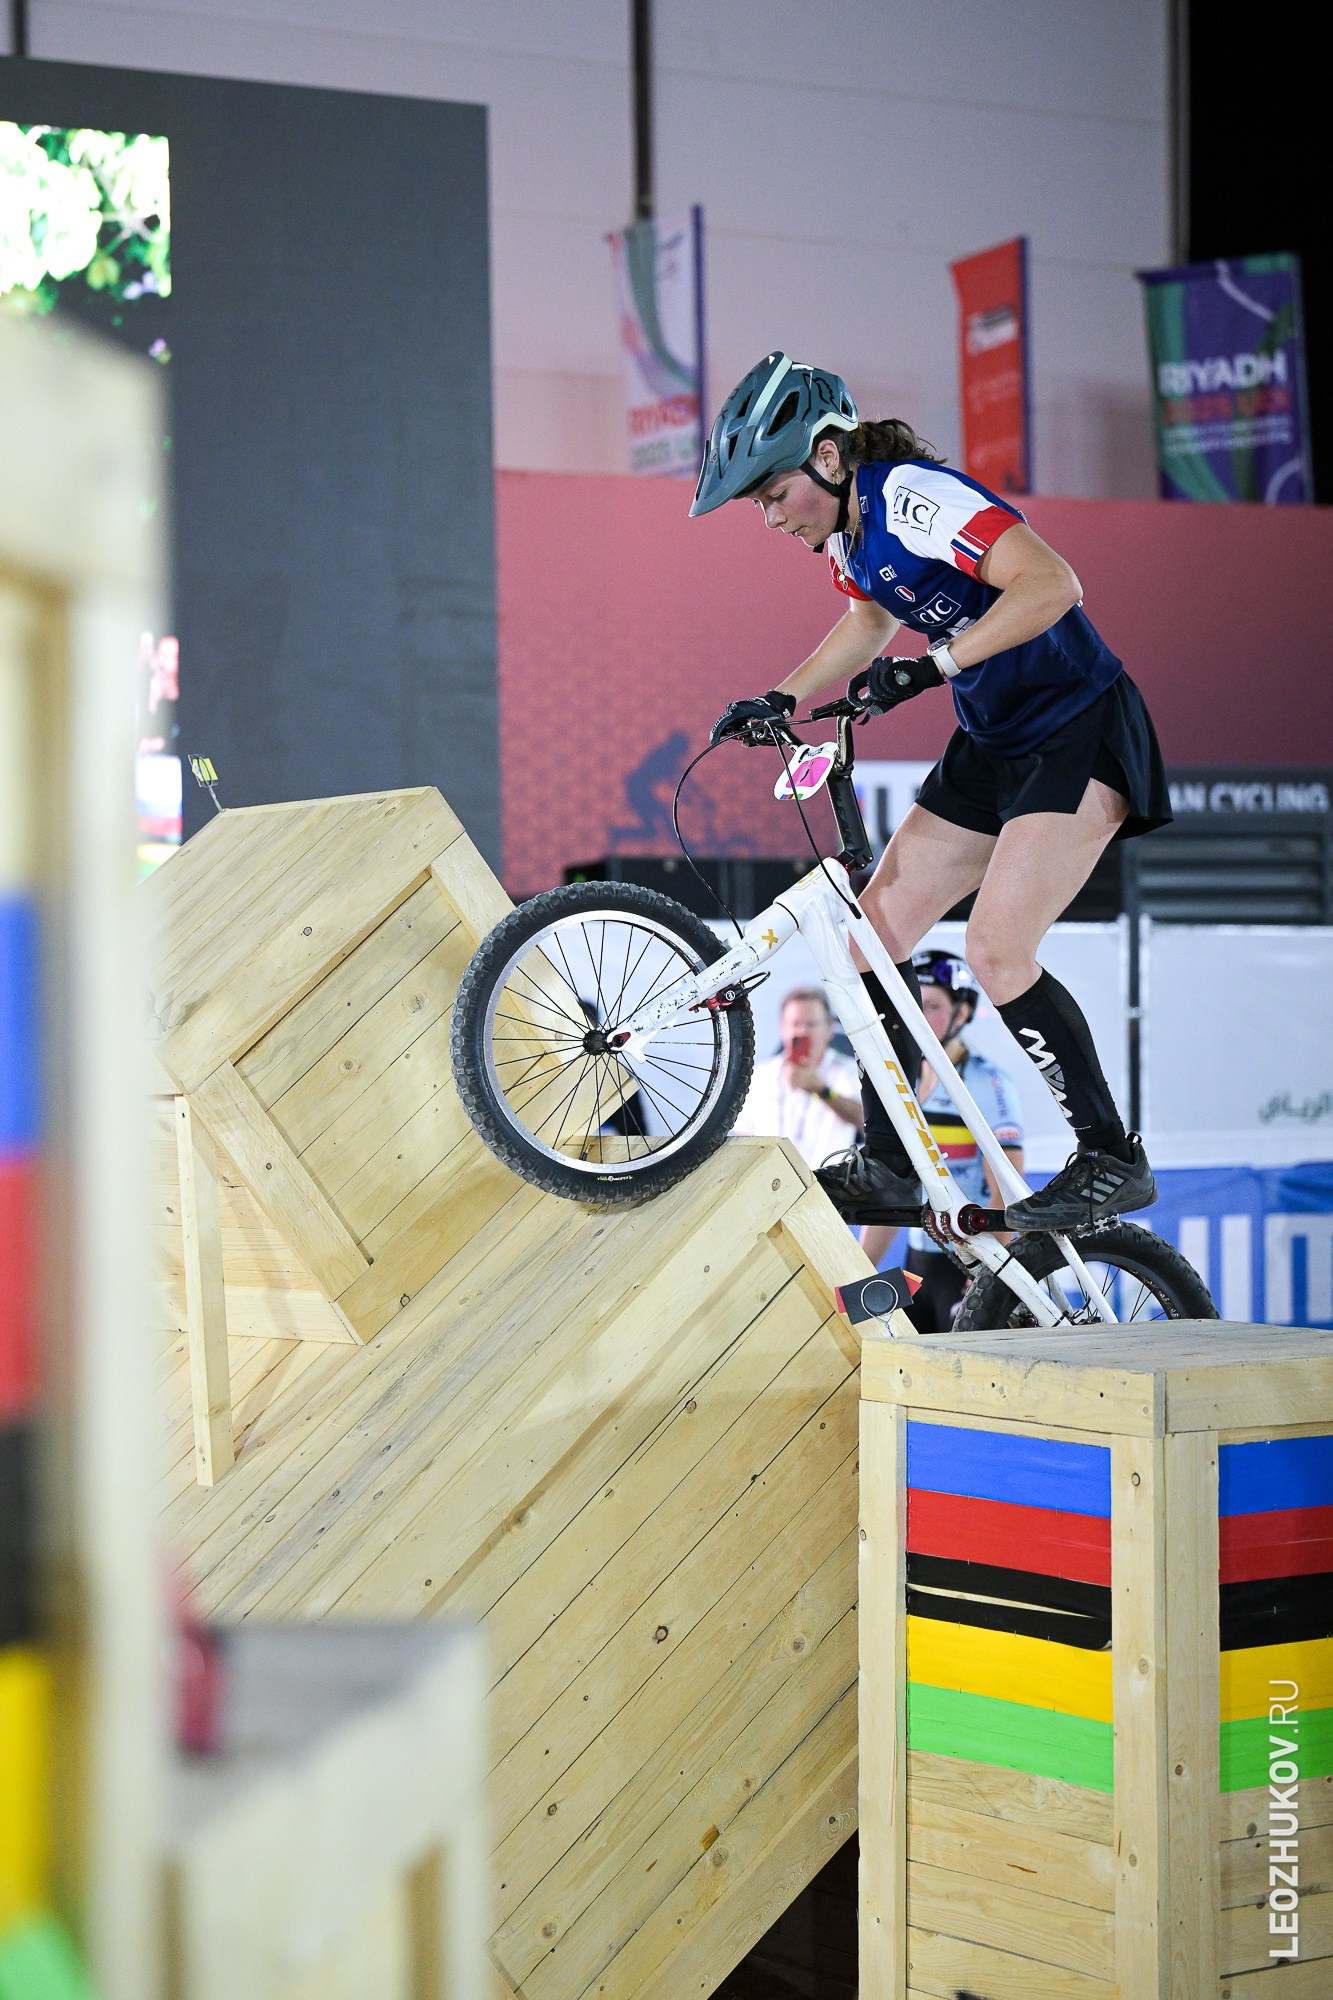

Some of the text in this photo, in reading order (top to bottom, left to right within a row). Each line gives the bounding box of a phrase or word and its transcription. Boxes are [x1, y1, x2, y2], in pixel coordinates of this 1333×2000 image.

[1158, 353, 1288, 394] RIYADH
[919, 599, 953, 624] CIC
[1208, 782, 1329, 814] CYCLING
